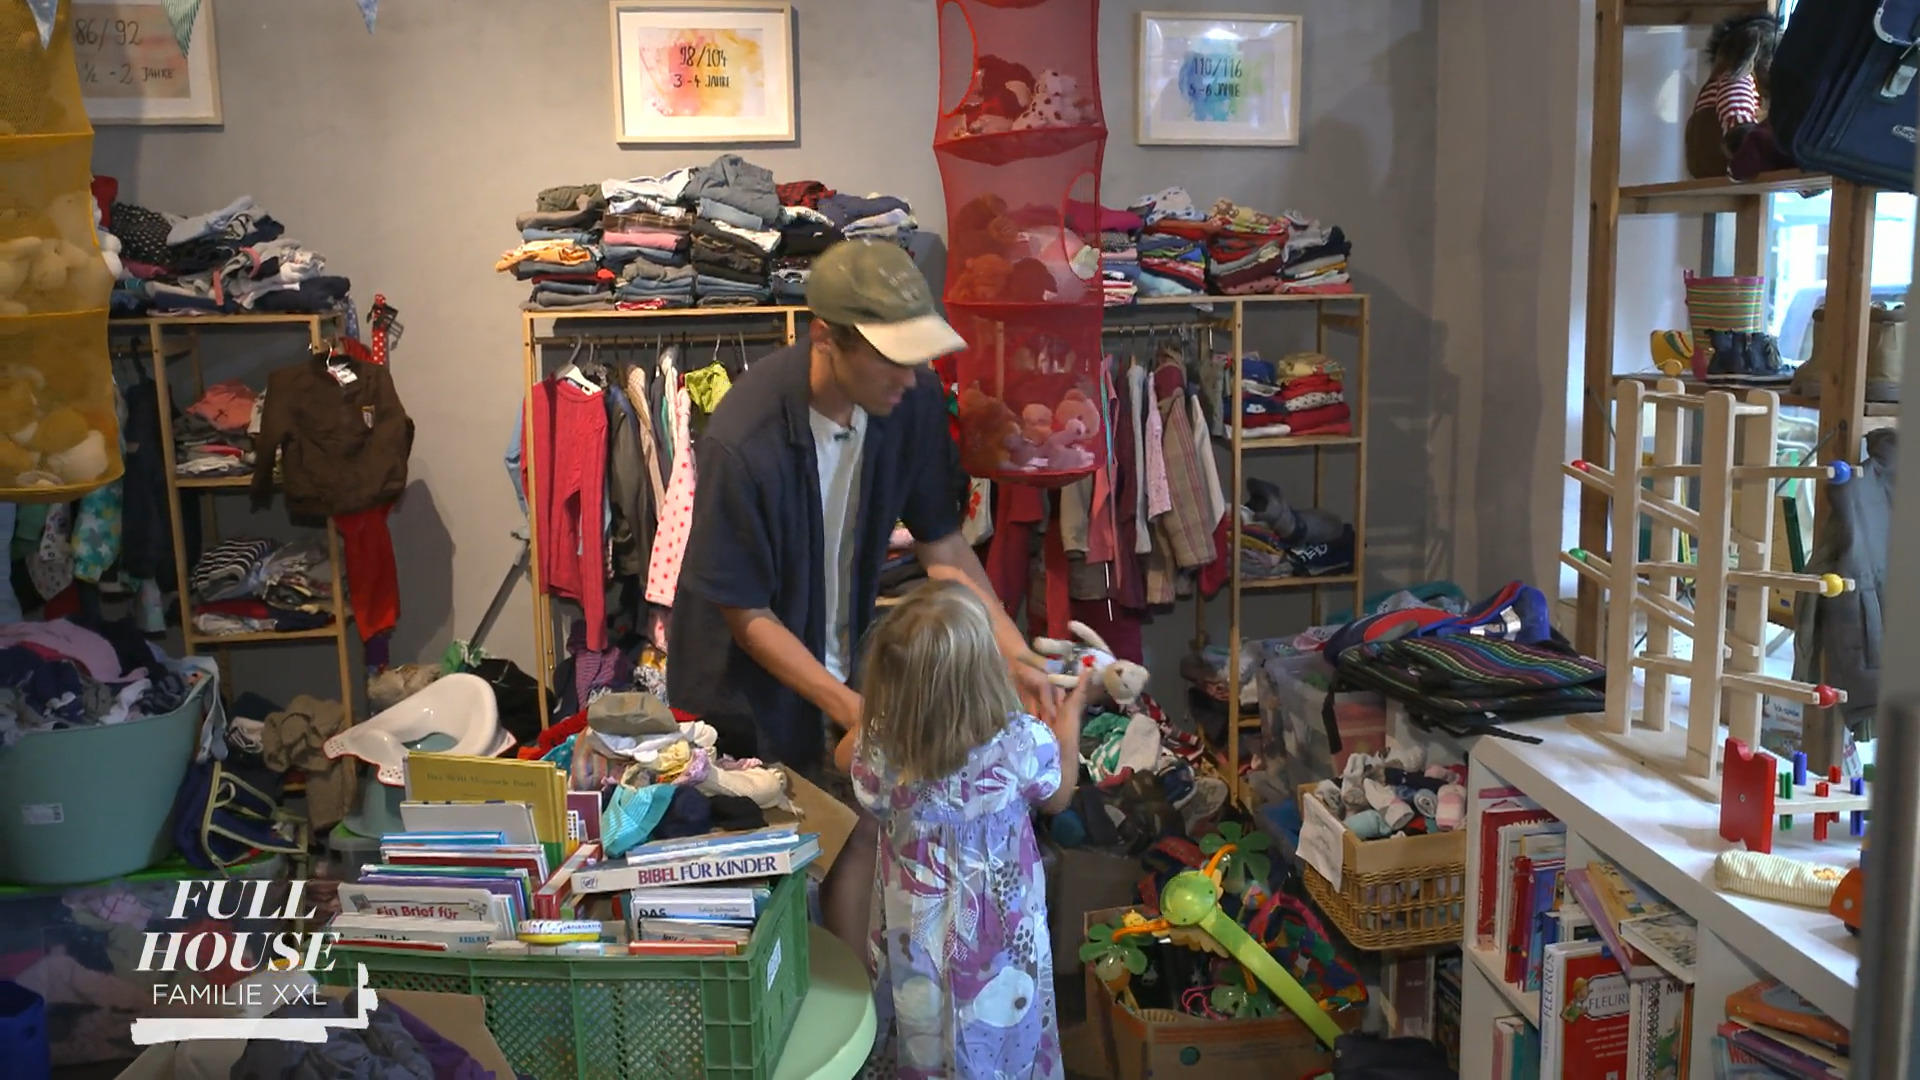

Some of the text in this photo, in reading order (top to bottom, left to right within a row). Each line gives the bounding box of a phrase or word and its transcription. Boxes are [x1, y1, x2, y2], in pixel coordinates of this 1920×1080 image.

[75, 18, 143, 51] 86/92
[680, 46, 727, 68] 98/104
[1193, 57, 1242, 78] 110/116
[142, 66, 174, 82] JAHRE
[637, 856, 777, 885] BIBEL FÜR KINDER
[400, 906, 434, 918] Brief
[439, 905, 459, 919] für
[1544, 953, 1556, 1018] FLEURUS
